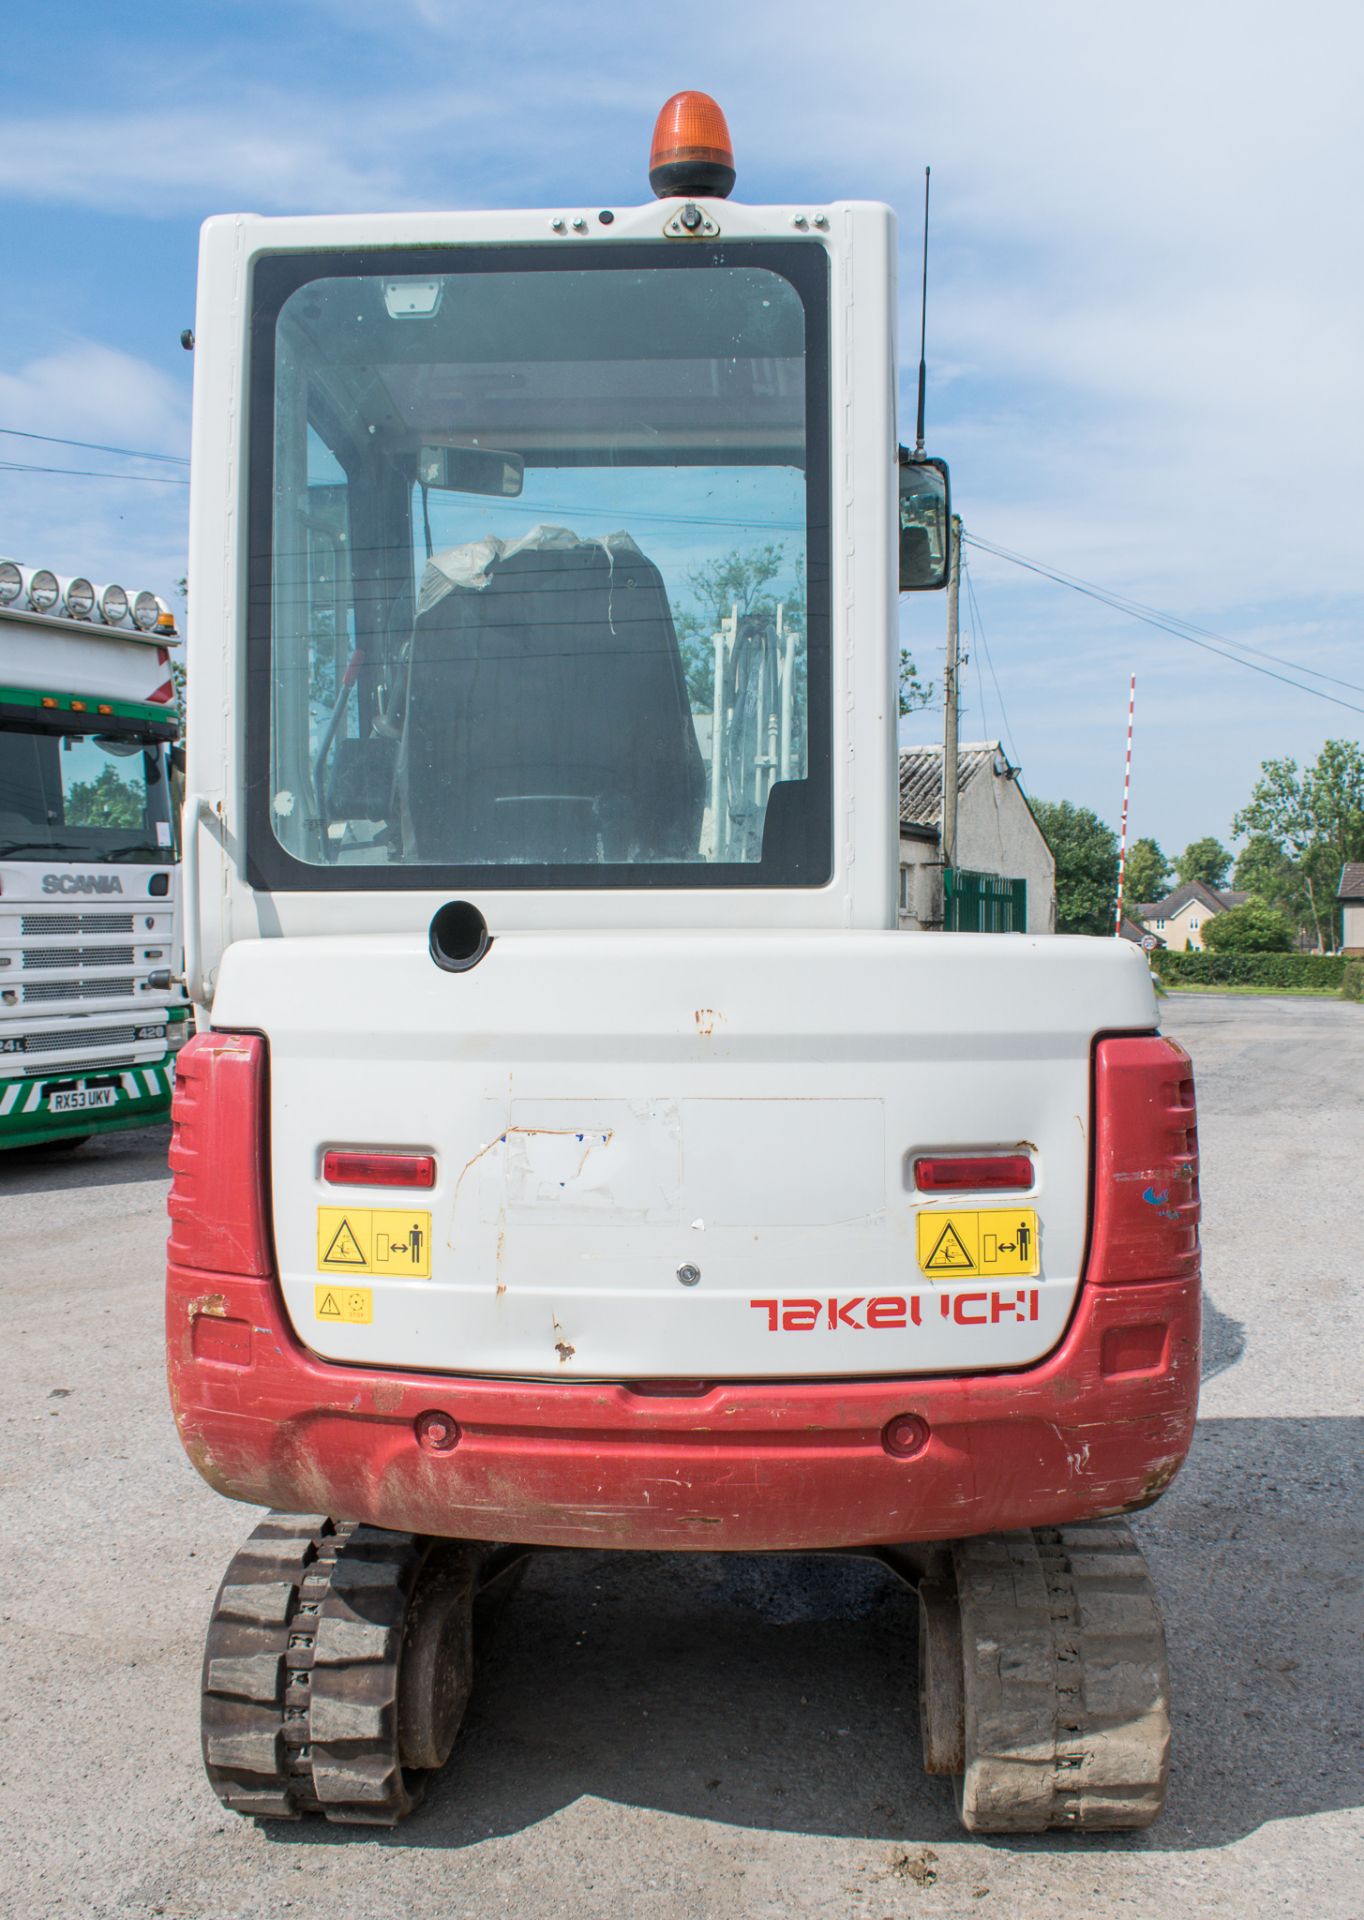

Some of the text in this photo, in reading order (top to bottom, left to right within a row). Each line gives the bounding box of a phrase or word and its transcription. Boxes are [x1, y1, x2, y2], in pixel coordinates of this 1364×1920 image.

[42, 874, 123, 894] SCANIA
[138, 1026, 164, 1039] 420
[55, 1089, 111, 1110] RX53 UKV
